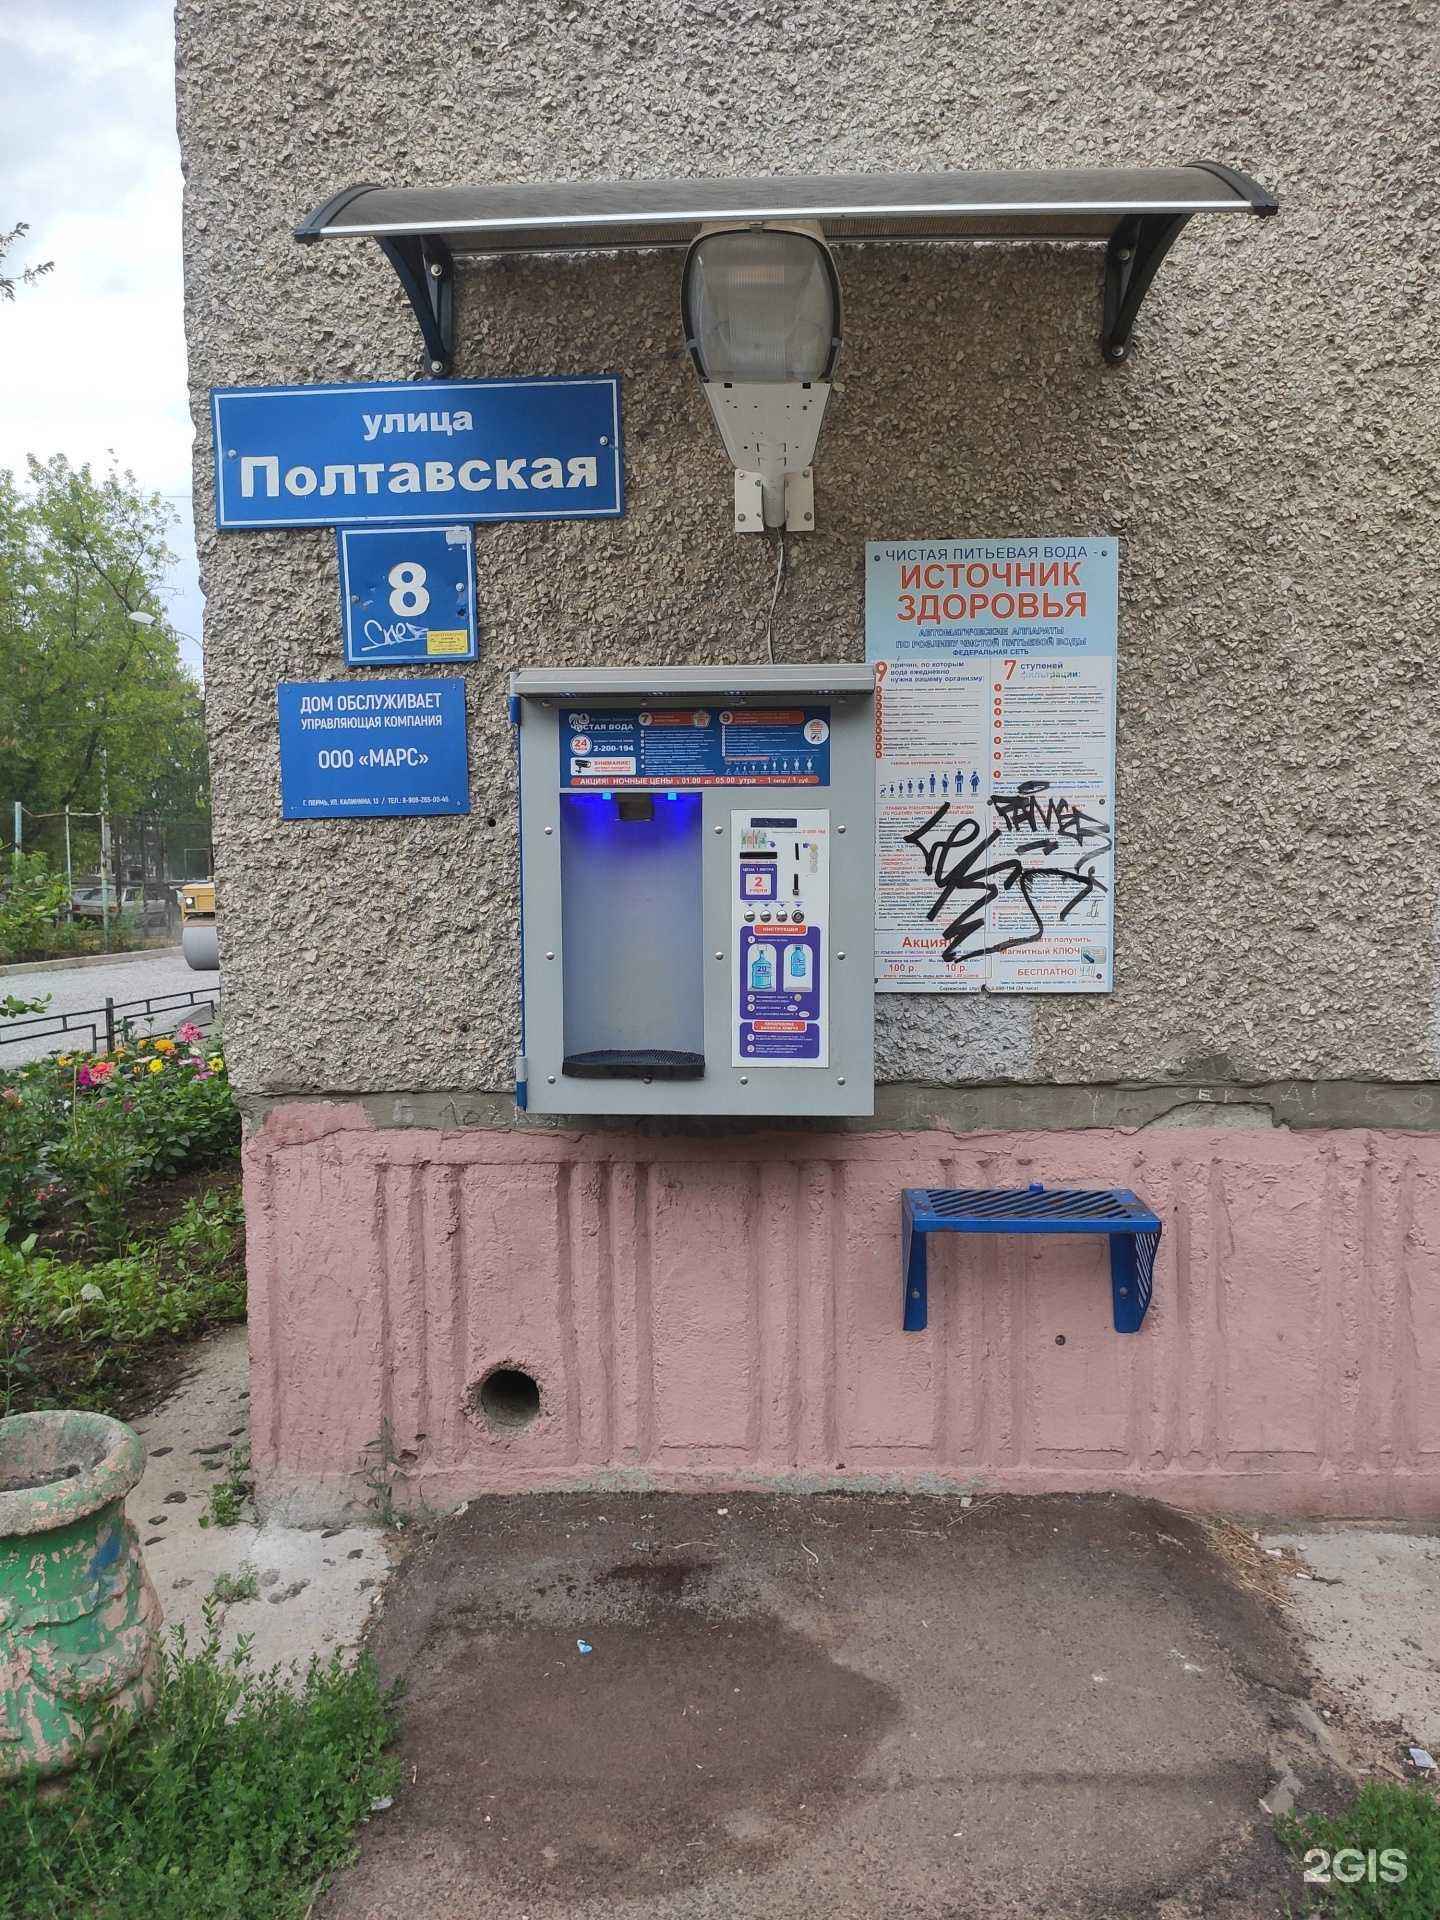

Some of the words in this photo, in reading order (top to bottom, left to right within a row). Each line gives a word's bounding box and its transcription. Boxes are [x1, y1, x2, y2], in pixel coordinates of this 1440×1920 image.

[362, 410, 473, 441] улица
[240, 455, 598, 498] Полтавская
[885, 549, 948, 561] ЧИСТАЯ
[953, 547, 1038, 559] ПИТЬЕВАЯ
[1044, 546, 1088, 559] ВОДА
[900, 561, 1082, 590] ИСТОЧНИК
[388, 561, 430, 617] 8
[896, 591, 1088, 625] ЗДОРОВЬЯ
[1010, 648, 1031, 656] СЕТЬ
[875, 661, 887, 682] 9
[1004, 660, 1017, 680] 7
[300, 696, 333, 714] ДОМ
[337, 693, 442, 711] ОБСЛУЖИВАЕТ
[301, 716, 382, 730] УПРАВЛЯЮЩАЯ
[384, 715, 443, 728] КОМПАНИЯ
[593, 744, 634, 752] 2-200-194
[318, 749, 354, 769] ООО
[358, 748, 429, 768] «МАРС»
[754, 876, 763, 887] 2
[889, 963, 905, 972] 100
[946, 964, 957, 972] 10
